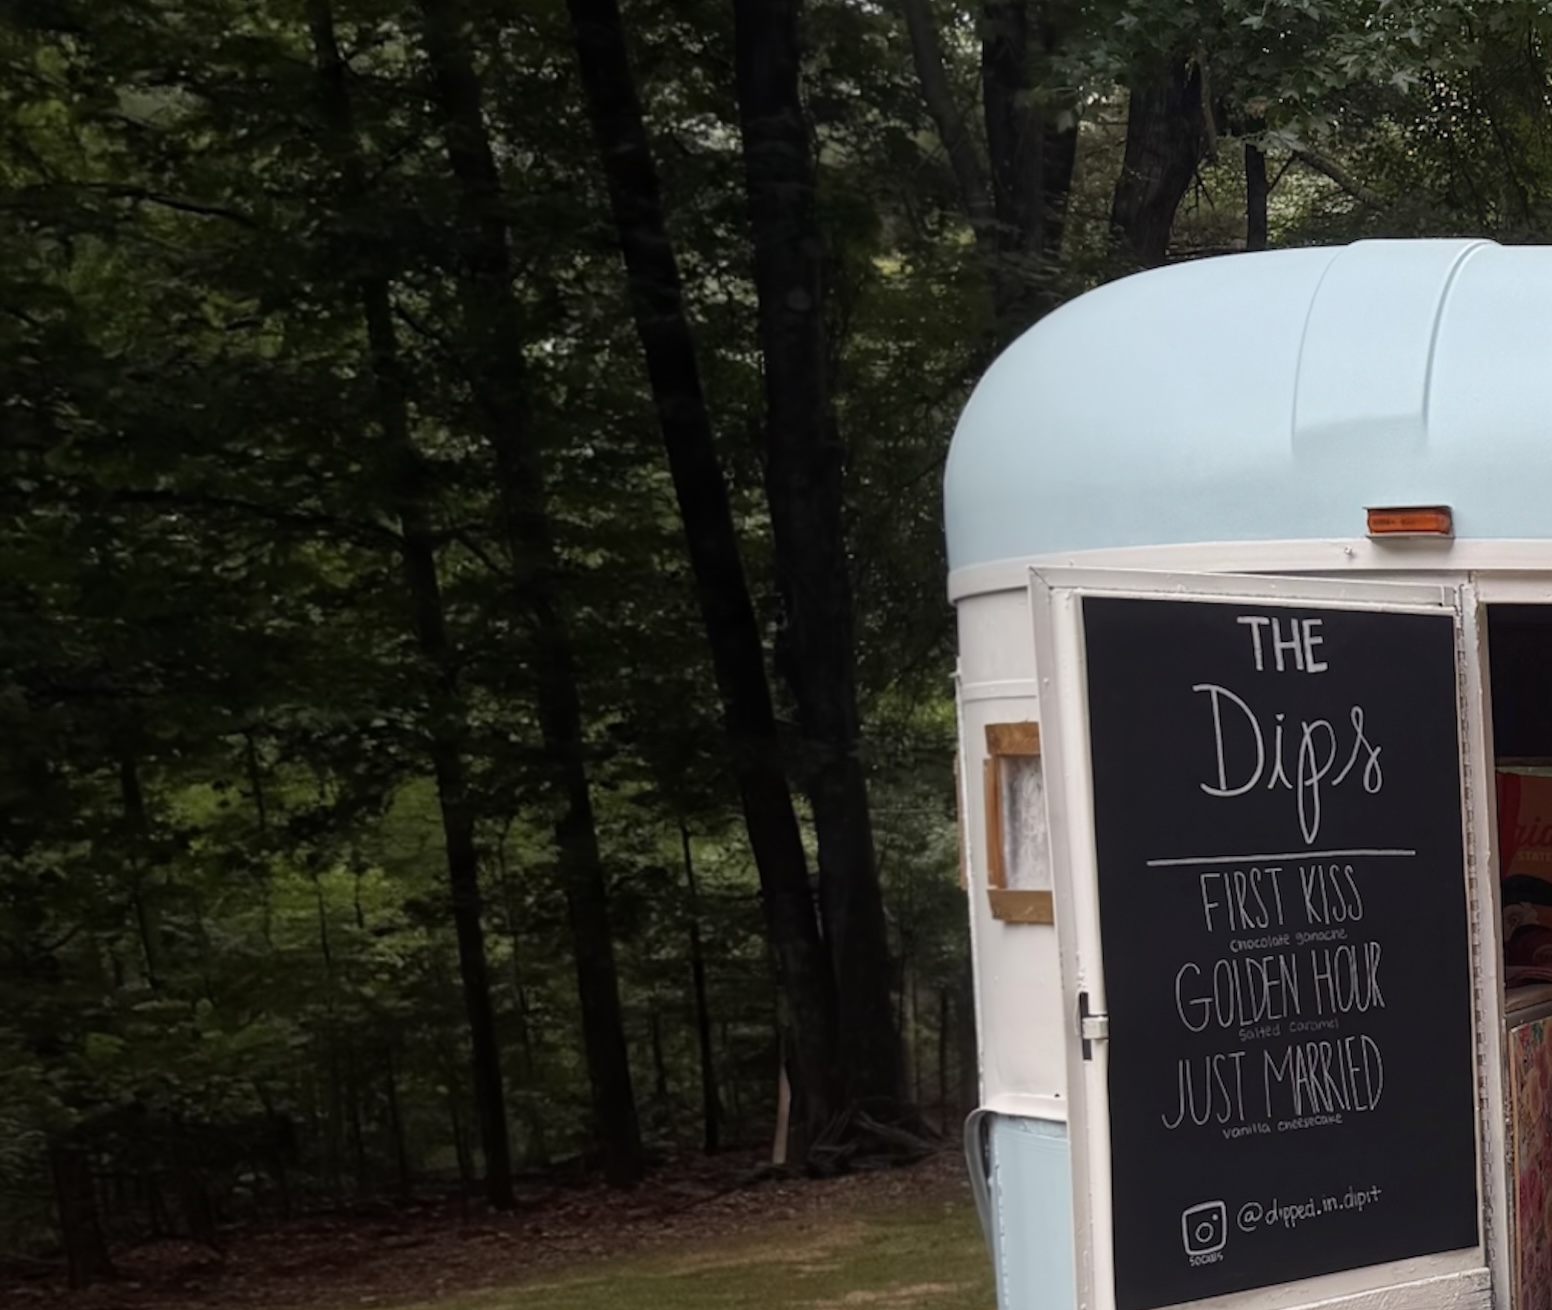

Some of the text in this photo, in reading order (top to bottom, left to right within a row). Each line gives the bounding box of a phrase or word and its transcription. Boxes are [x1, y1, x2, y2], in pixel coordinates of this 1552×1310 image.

[1237, 615, 1328, 674] THE
[1192, 683, 1383, 845] Dips
[1517, 850, 1552, 863] STATE
[1200, 863, 1364, 932] FIRST KISS
[1174, 940, 1386, 1033] GOLDEN HOUR
[1289, 1017, 1340, 1033] caramel
[1161, 1033, 1385, 1130] JUST MARRIED
[1222, 1112, 1344, 1140] vanilla cheesecake
[1236, 1184, 1383, 1233] @dipped.in.dipit
